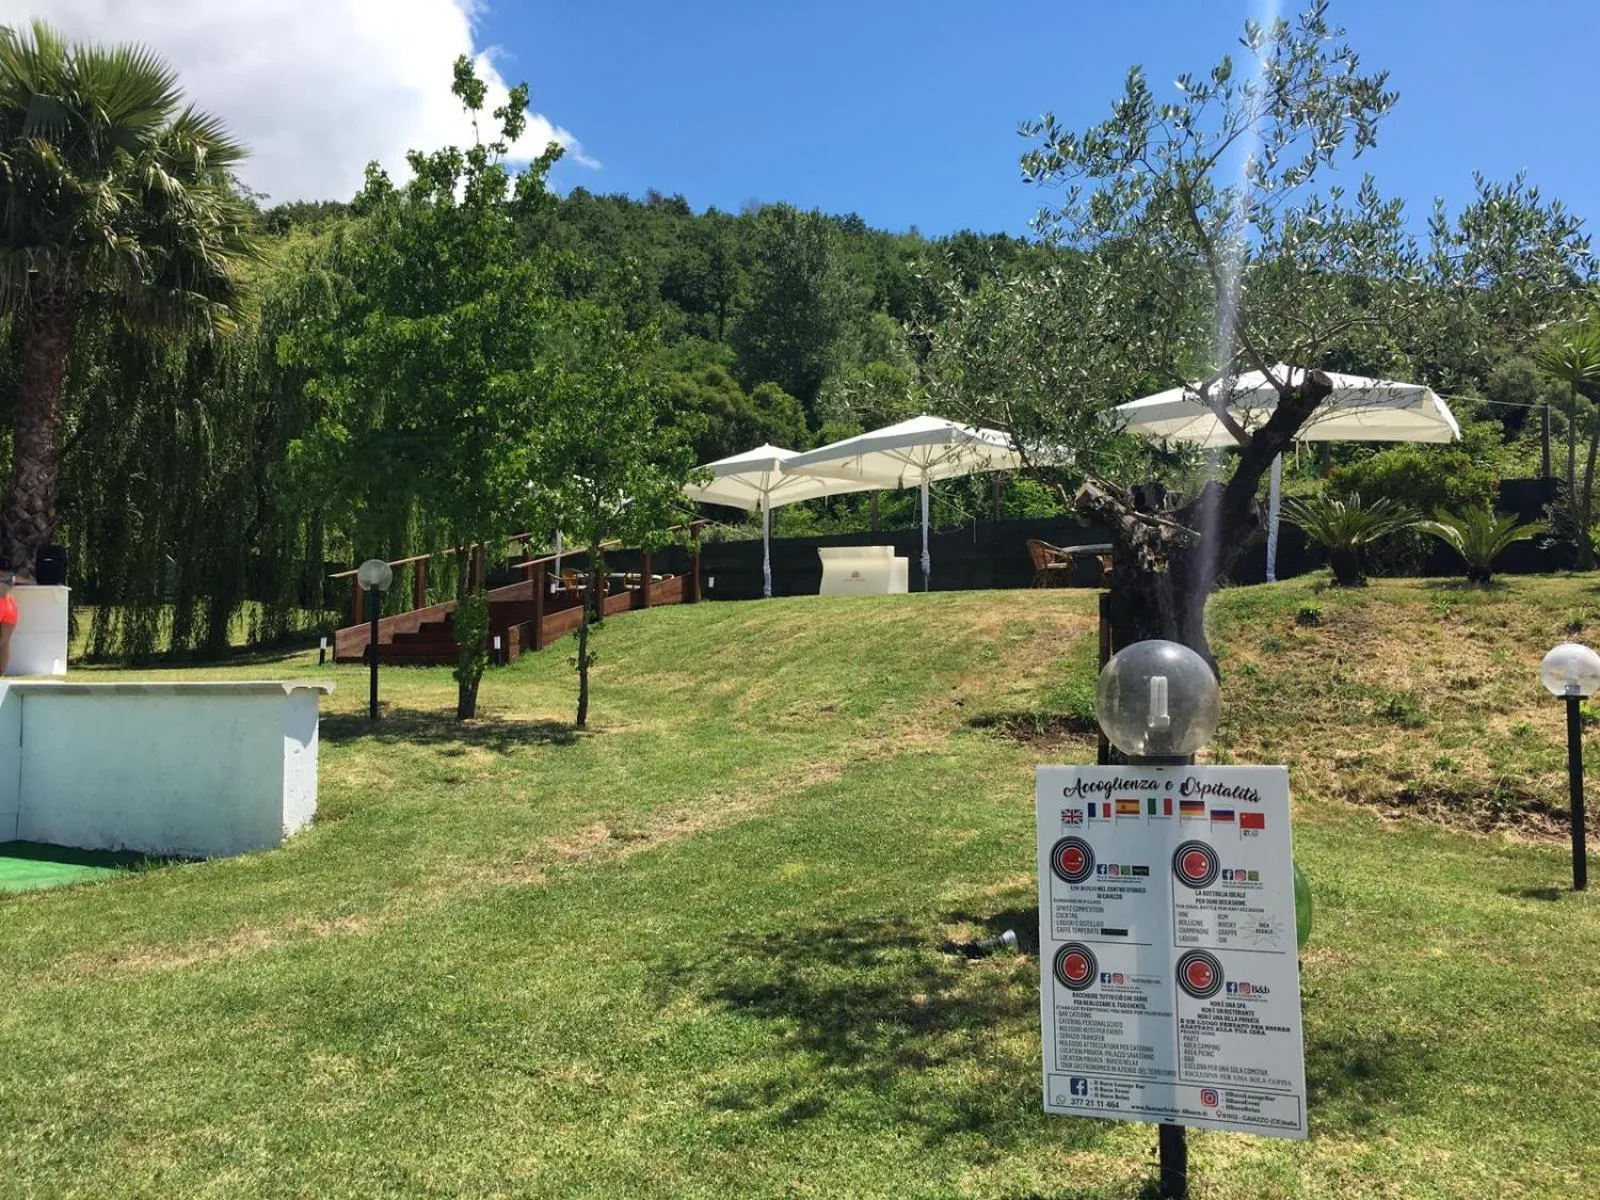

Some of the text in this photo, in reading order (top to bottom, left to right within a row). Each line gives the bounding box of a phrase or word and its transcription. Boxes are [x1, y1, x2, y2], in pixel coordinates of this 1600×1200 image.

[1063, 776, 1262, 803] Accoglienza e Ospitalità
[1252, 984, 1270, 994] B&b
[1084, 1041, 1119, 1049] ATTREZZATURA
[1130, 1044, 1154, 1052] CATERING
[1074, 1062, 1110, 1071] GASTRONOMICO
[1243, 1115, 1269, 1124] CAIAZZO
